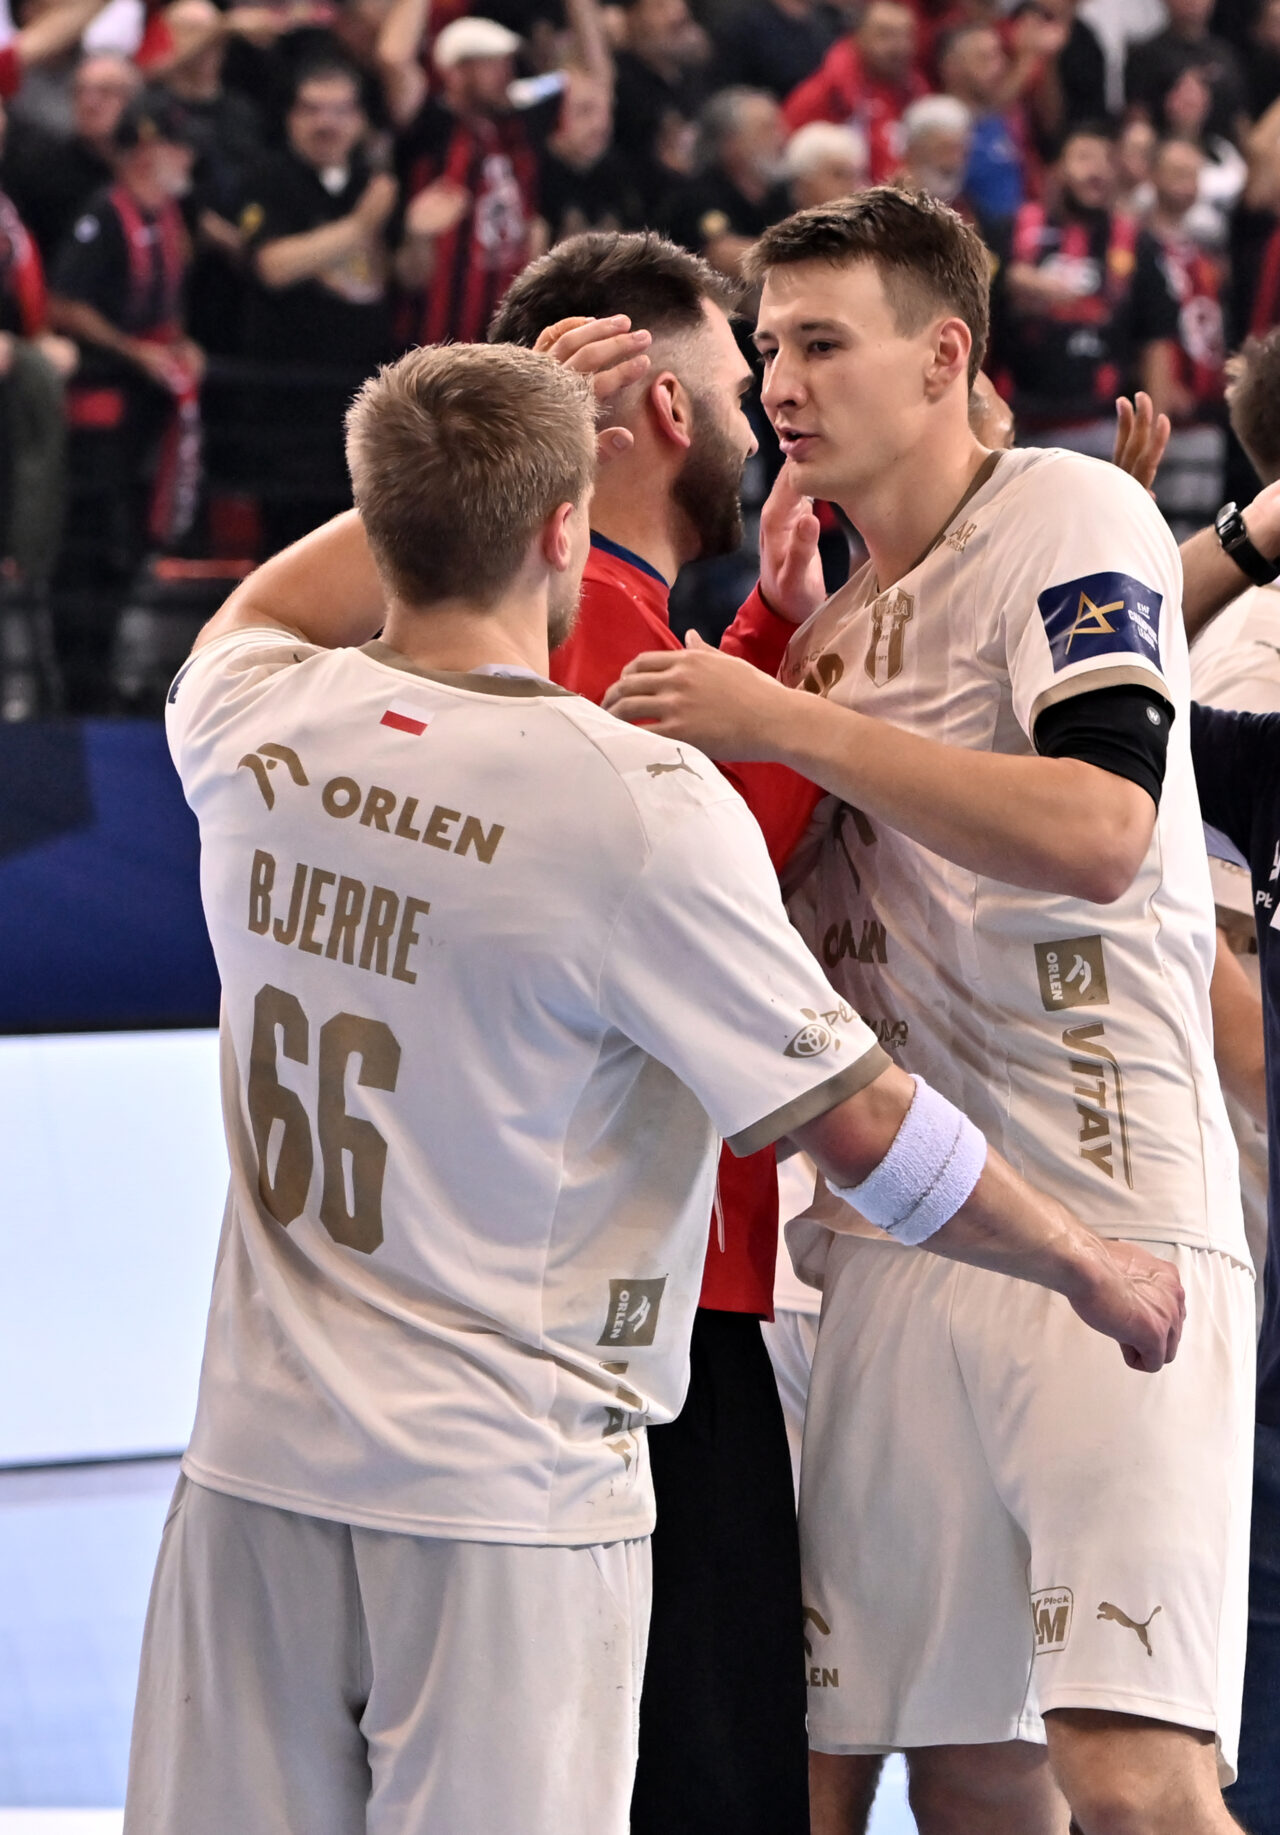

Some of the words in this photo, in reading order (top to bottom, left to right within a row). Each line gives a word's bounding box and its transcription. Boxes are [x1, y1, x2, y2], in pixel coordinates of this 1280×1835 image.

[322, 776, 506, 864] ORLEN
[247, 848, 431, 985] BJERRE
[1046, 951, 1063, 1001] ORLEN
[246, 983, 402, 1256] 66
[1062, 1021, 1120, 1180] VITAY
[609, 1289, 630, 1340] ORLEN
